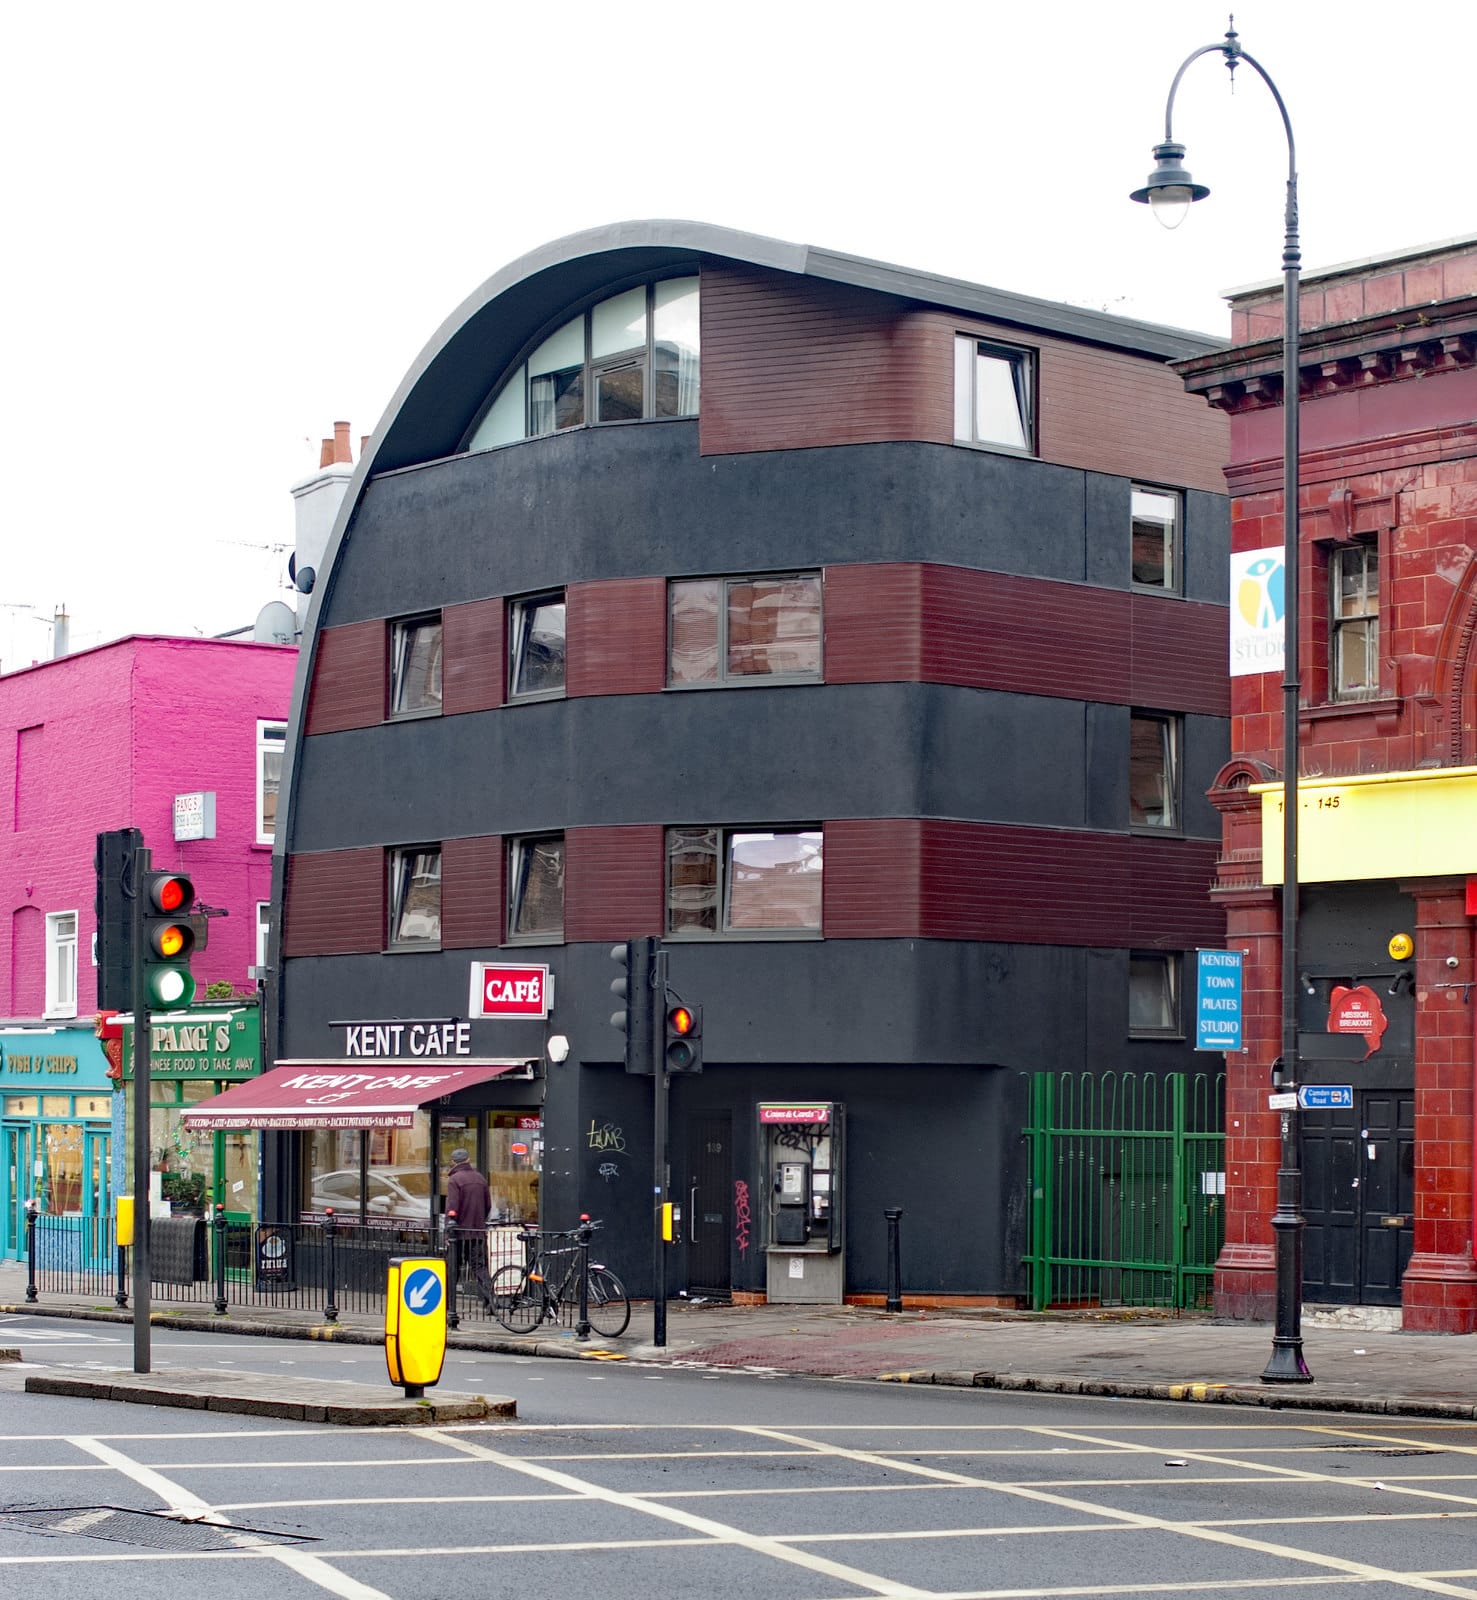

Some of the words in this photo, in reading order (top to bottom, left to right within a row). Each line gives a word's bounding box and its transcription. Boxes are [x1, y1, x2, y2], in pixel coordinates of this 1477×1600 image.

[1319, 796, 1340, 809] 145
[1391, 944, 1406, 952] Yale
[1201, 955, 1240, 967] KENTISH
[1206, 976, 1235, 988] TOWN
[486, 976, 540, 1003] CAFÉ
[1202, 998, 1237, 1010] PILATES
[1200, 1020, 1239, 1033] STUDIO
[1339, 1019, 1372, 1027] BREAKOUT
[152, 1022, 230, 1052] PANG'S
[346, 1024, 404, 1056] KENT
[409, 1023, 471, 1055] CAFE
[7, 1055, 31, 1073] FISH
[45, 1055, 77, 1073] CHIPS
[174, 1058, 196, 1071] FOOD
[198, 1058, 209, 1071] TO
[212, 1058, 232, 1071] TAKE
[235, 1057, 254, 1071] AWAY
[280, 1073, 376, 1089] KENT
[1308, 1089, 1330, 1097] Camden
